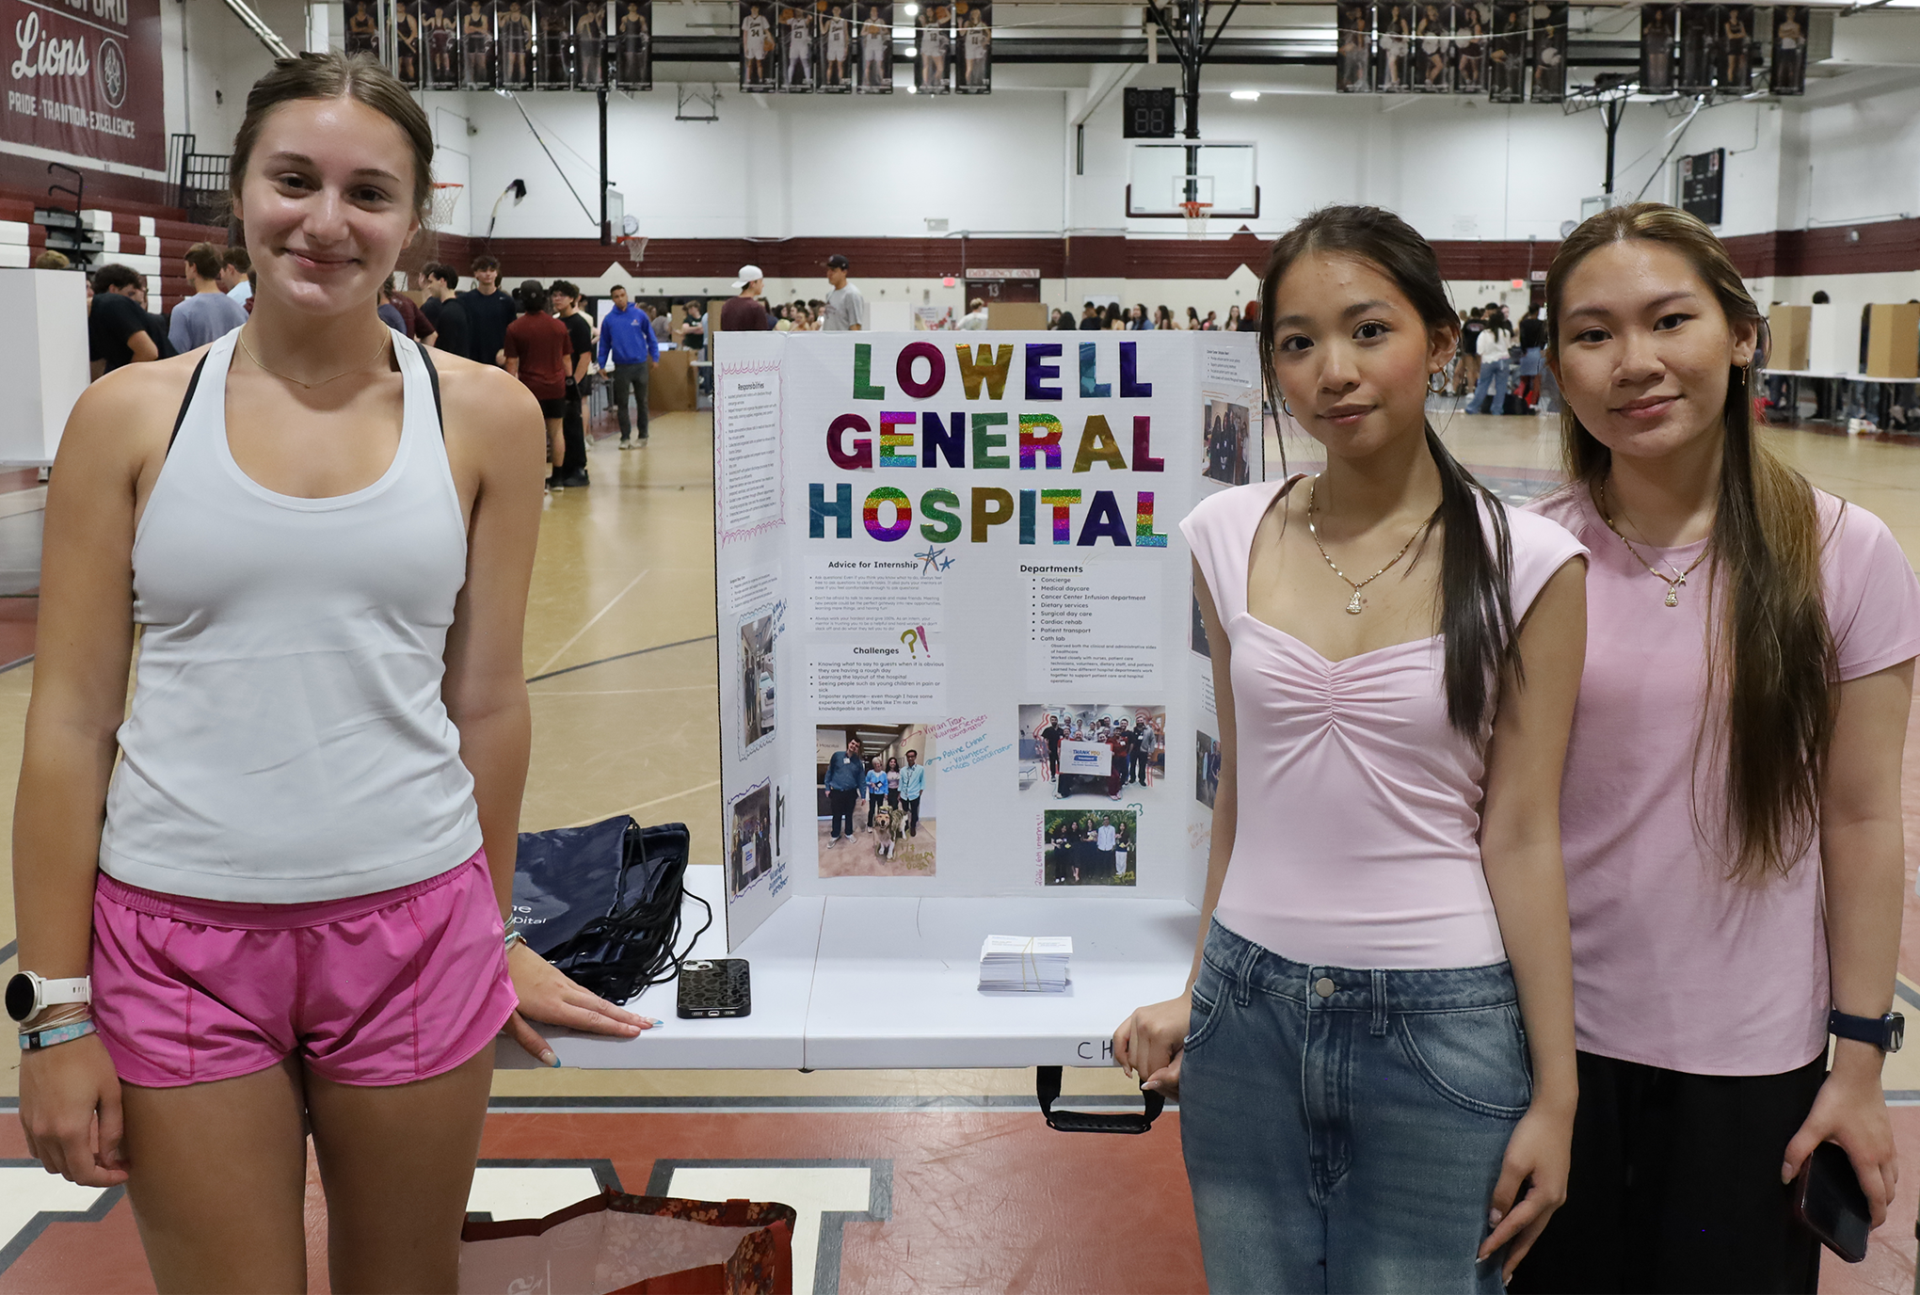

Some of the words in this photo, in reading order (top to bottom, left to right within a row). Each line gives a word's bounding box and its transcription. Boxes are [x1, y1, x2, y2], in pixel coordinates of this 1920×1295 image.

[12, 11, 90, 80] Lions
[750, 28, 760, 38] 34
[8, 90, 37, 116] PRIDE
[90, 111, 135, 139] EXCELLENCE
[988, 284, 999, 297] 13
[852, 341, 1152, 401] LOWELL
[826, 411, 1164, 472] GENERAL
[808, 483, 1168, 548] HOSPITAL
[874, 561, 918, 570] Internship
[1020, 564, 1083, 574] Departments
[853, 647, 900, 656] Challenges
